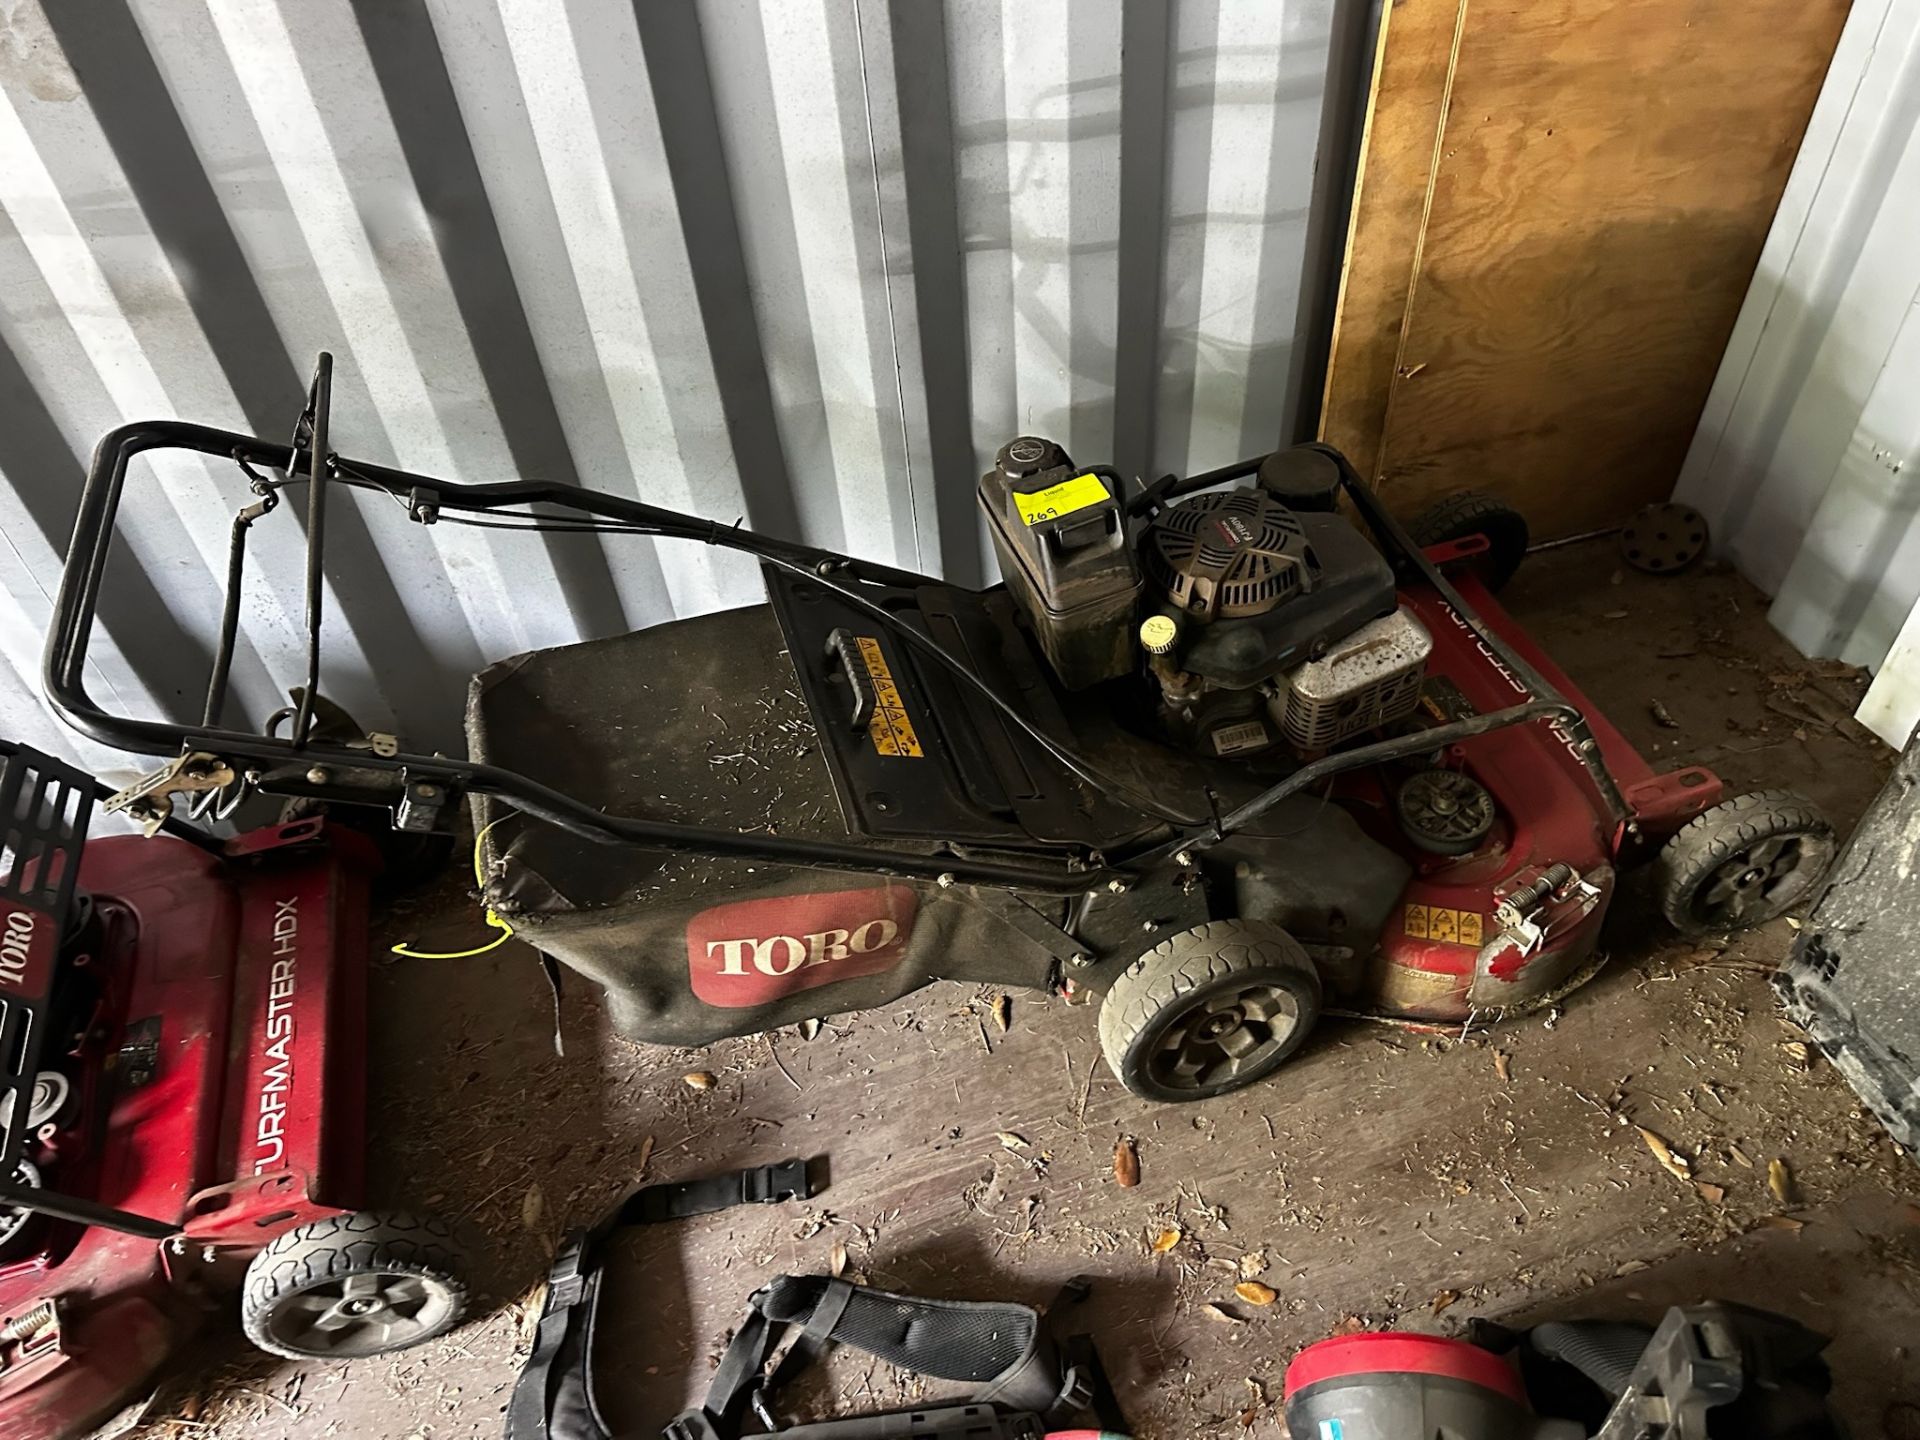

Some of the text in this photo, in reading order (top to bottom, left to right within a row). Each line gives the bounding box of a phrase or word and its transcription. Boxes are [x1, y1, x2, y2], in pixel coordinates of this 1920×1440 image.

[1026, 507, 1058, 524] 269
[706, 918, 899, 977] TORO
[254, 895, 299, 1177] URFMASTER HDX
